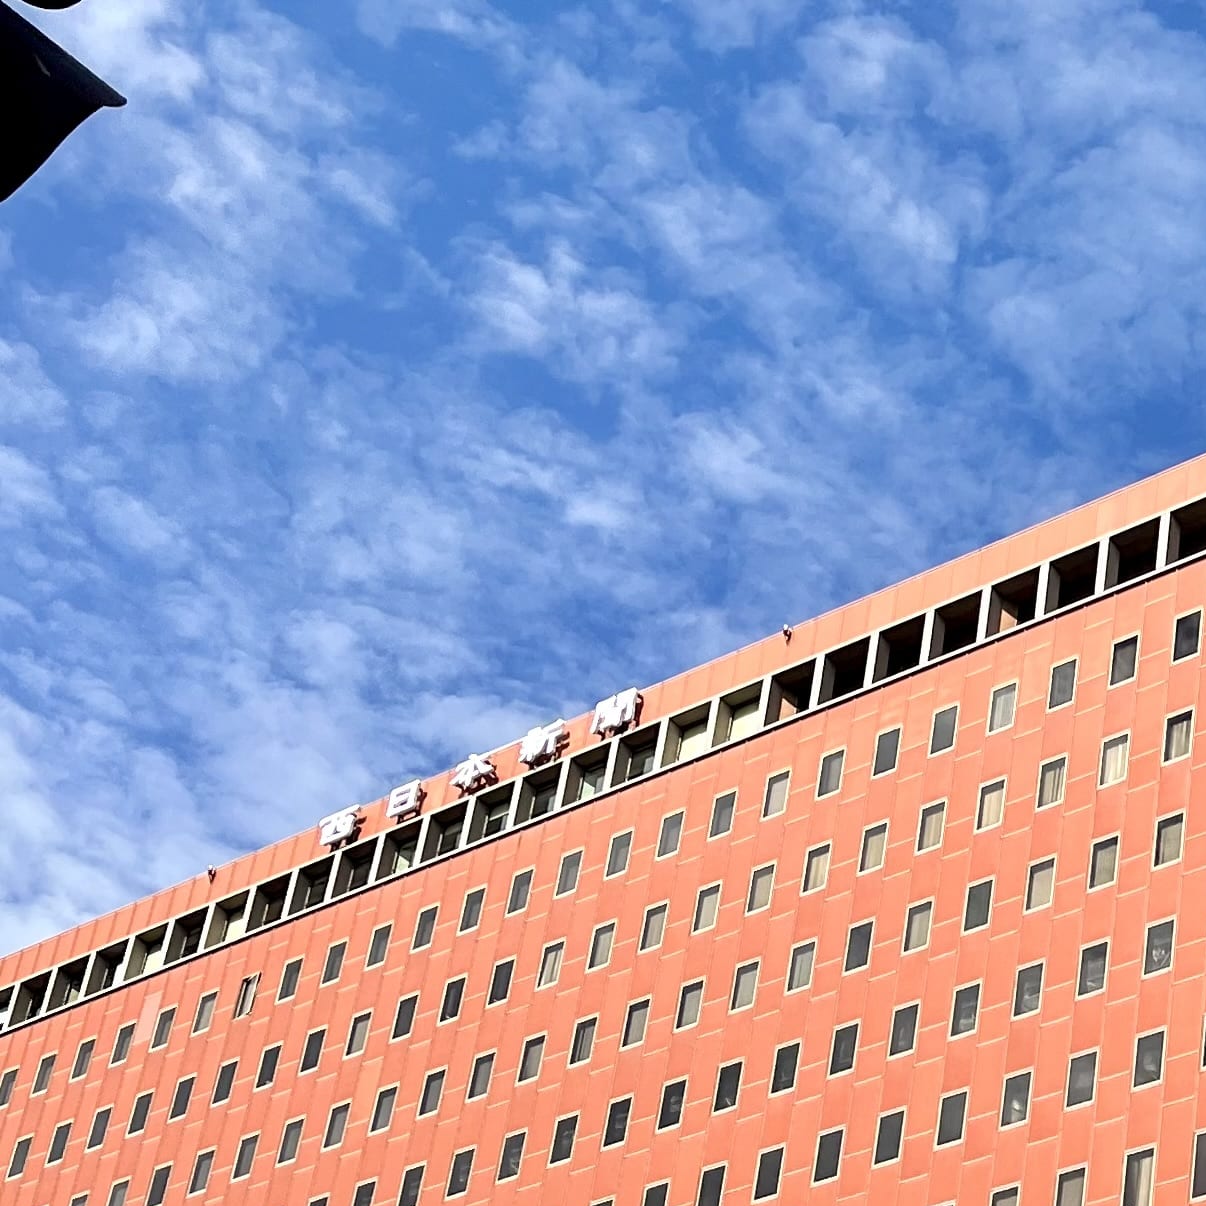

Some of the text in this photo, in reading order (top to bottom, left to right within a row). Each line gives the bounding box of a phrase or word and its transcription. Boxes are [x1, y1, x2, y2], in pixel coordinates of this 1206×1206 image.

[318, 686, 638, 846] 西日本新聞
